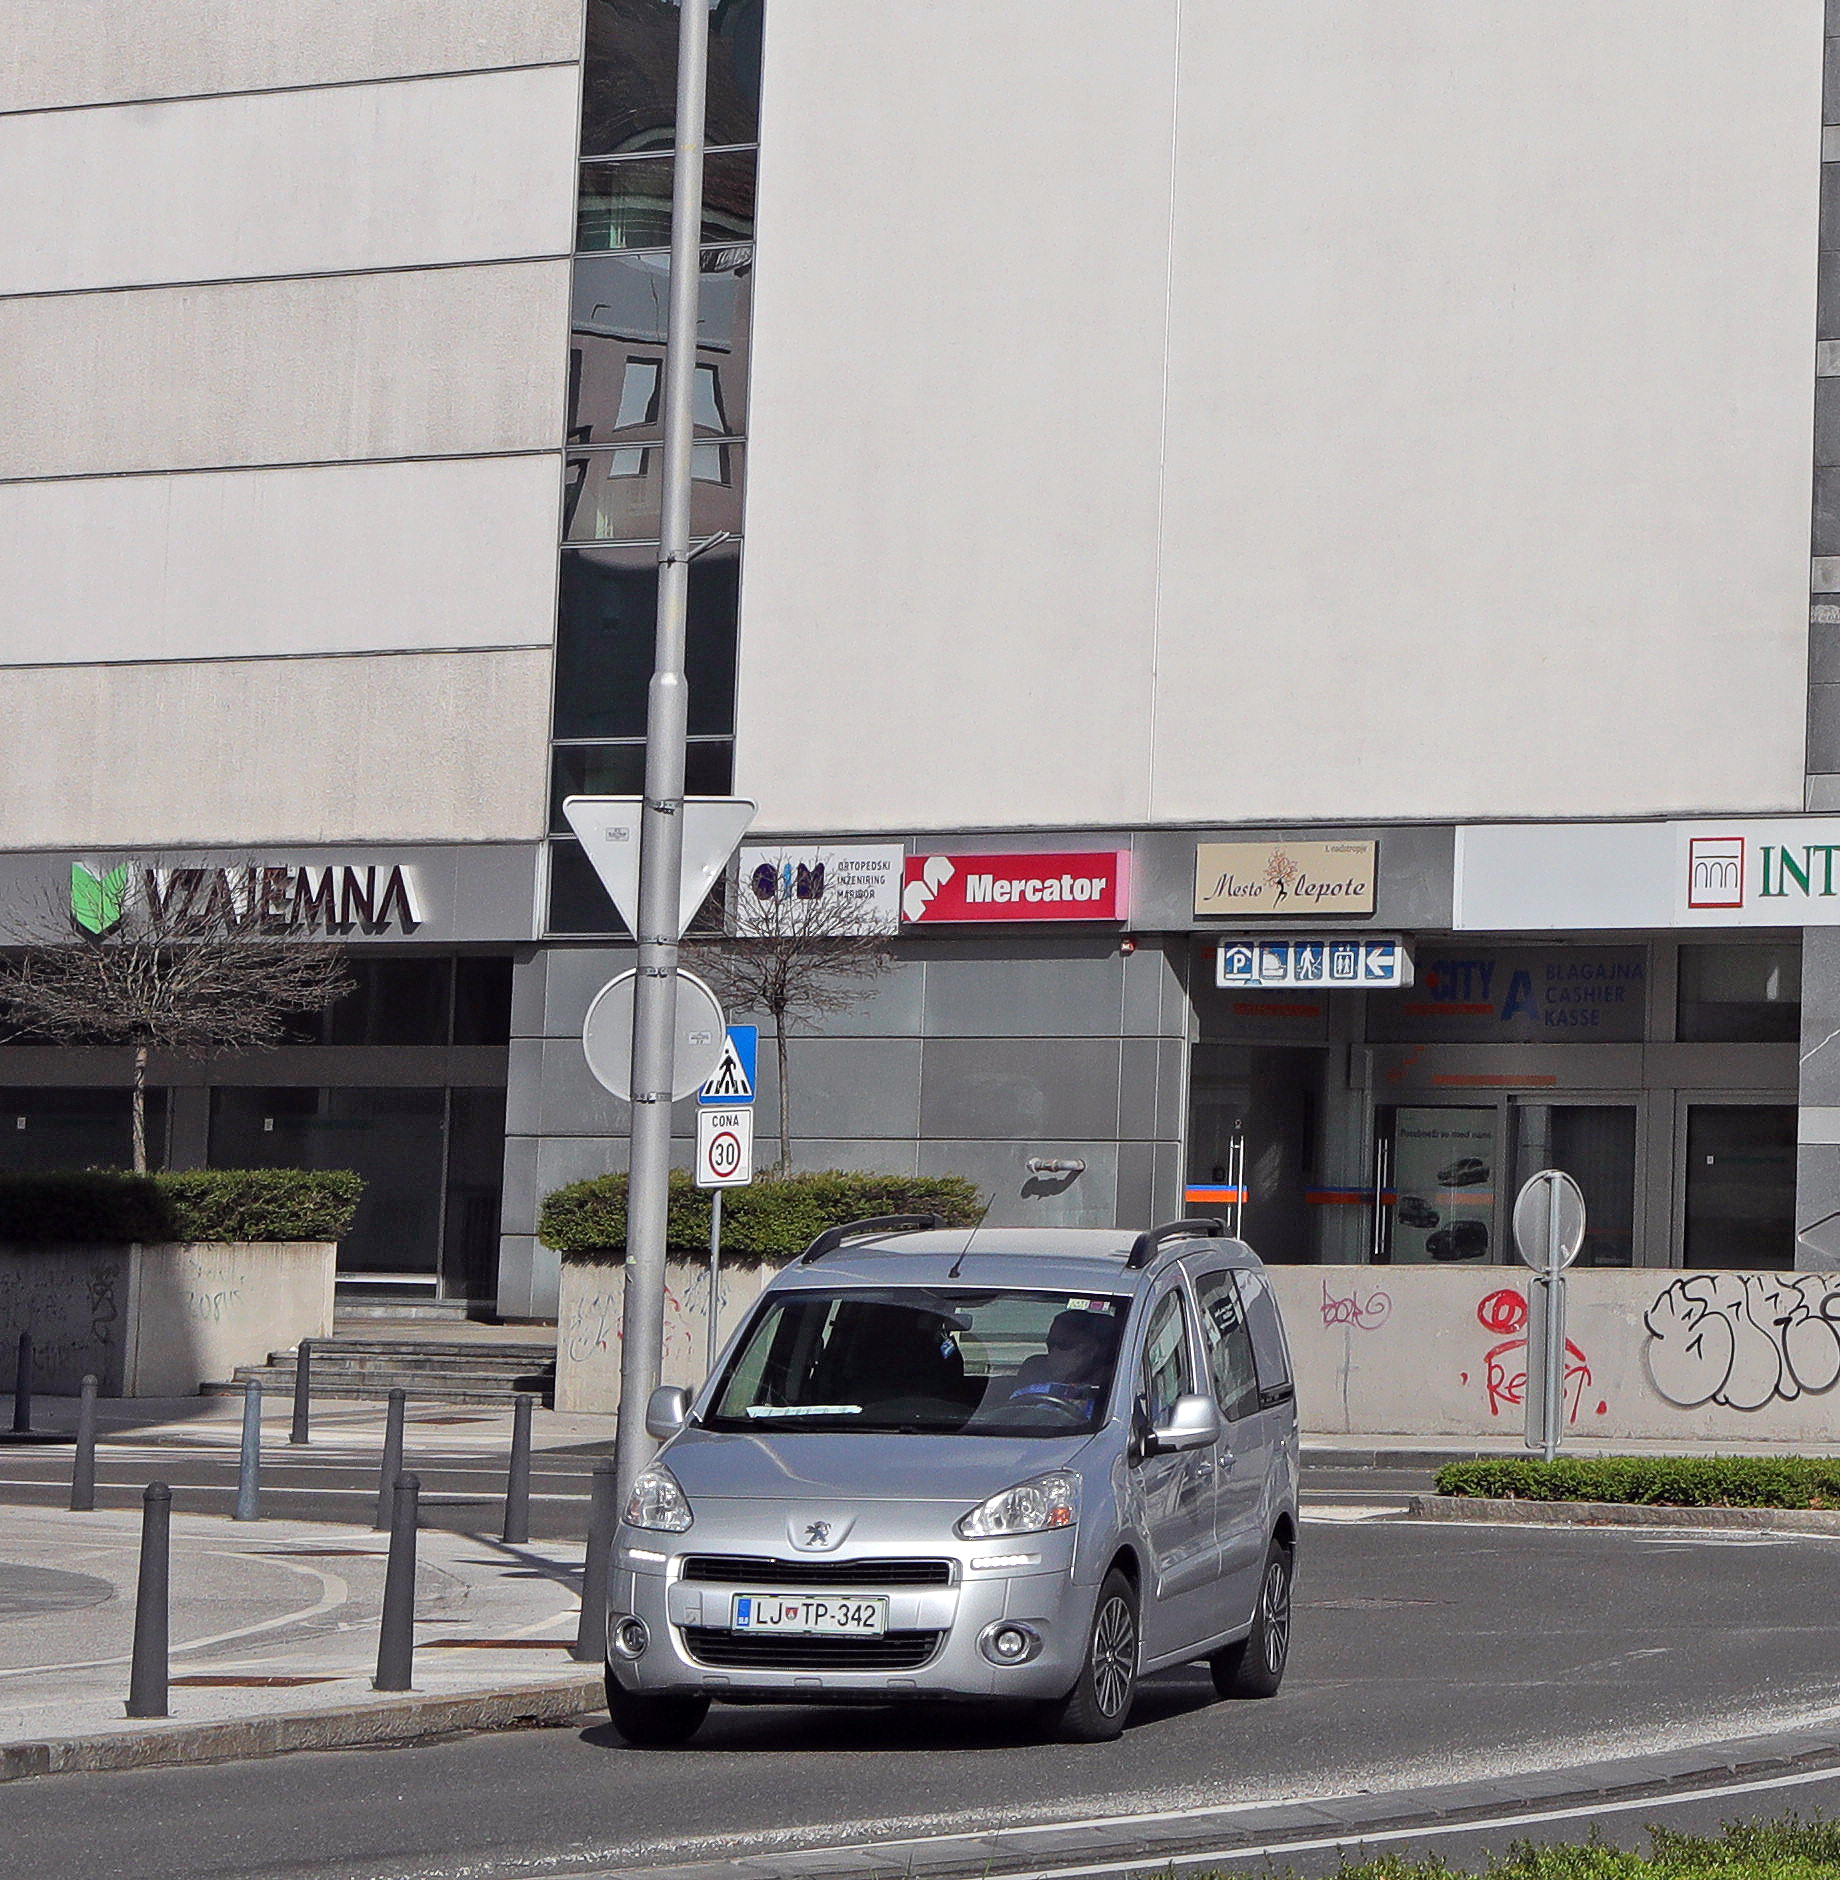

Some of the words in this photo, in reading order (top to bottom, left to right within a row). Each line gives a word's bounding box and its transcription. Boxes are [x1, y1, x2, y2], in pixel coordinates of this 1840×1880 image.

[837, 860, 891, 872] ORTOPEDSKI
[965, 874, 1106, 903] Mercator
[1203, 873, 1263, 901] Mesto
[1293, 874, 1366, 903] lepote
[1545, 963, 1643, 981] BLAGAJNA
[1544, 986, 1626, 1004] CASHIER
[1544, 1009, 1601, 1027] KASSE
[712, 1115, 739, 1127] CONA
[715, 1143, 735, 1166] 30
[756, 1601, 783, 1624] LJ
[802, 1603, 876, 1628] TP-342
